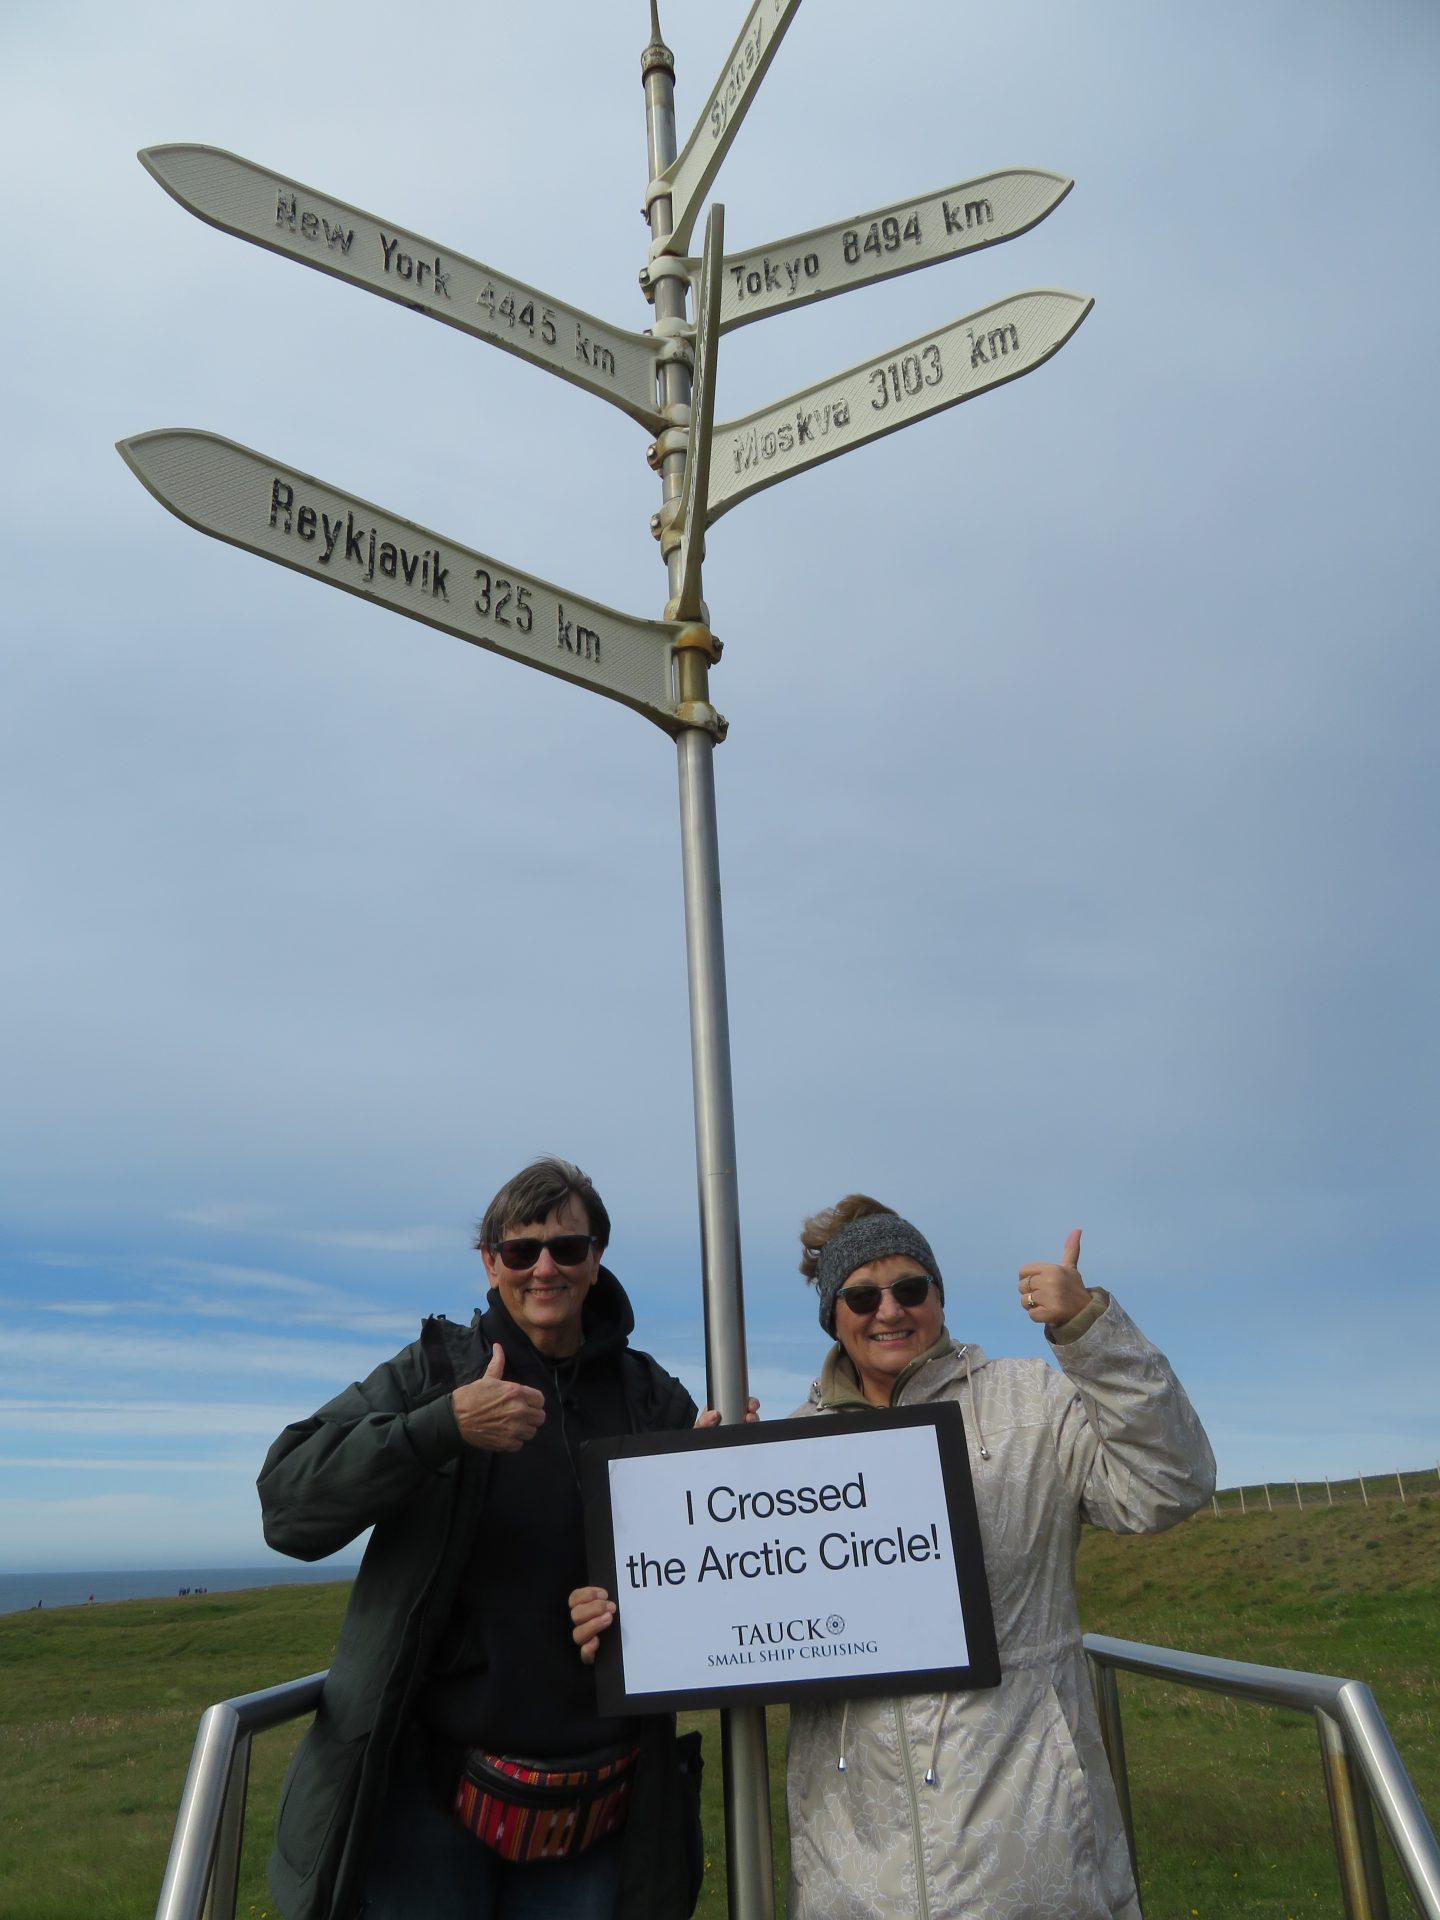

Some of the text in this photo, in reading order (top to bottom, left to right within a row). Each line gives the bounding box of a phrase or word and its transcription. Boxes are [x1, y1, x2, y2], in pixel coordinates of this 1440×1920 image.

[276, 189, 616, 376] New York 4445 km
[730, 197, 994, 301] Tokyo 8494 km
[732, 321, 1020, 473] Moskva 3103 km
[473, 568, 533, 633] 325
[558, 603, 601, 663] km
[686, 1472, 868, 1525] I Crossed
[626, 1523, 942, 1589] the Arctic Circle!
[707, 1640, 879, 1667] SMALL SHIP CRUISING
[731, 1617, 827, 1647] TAUCK
